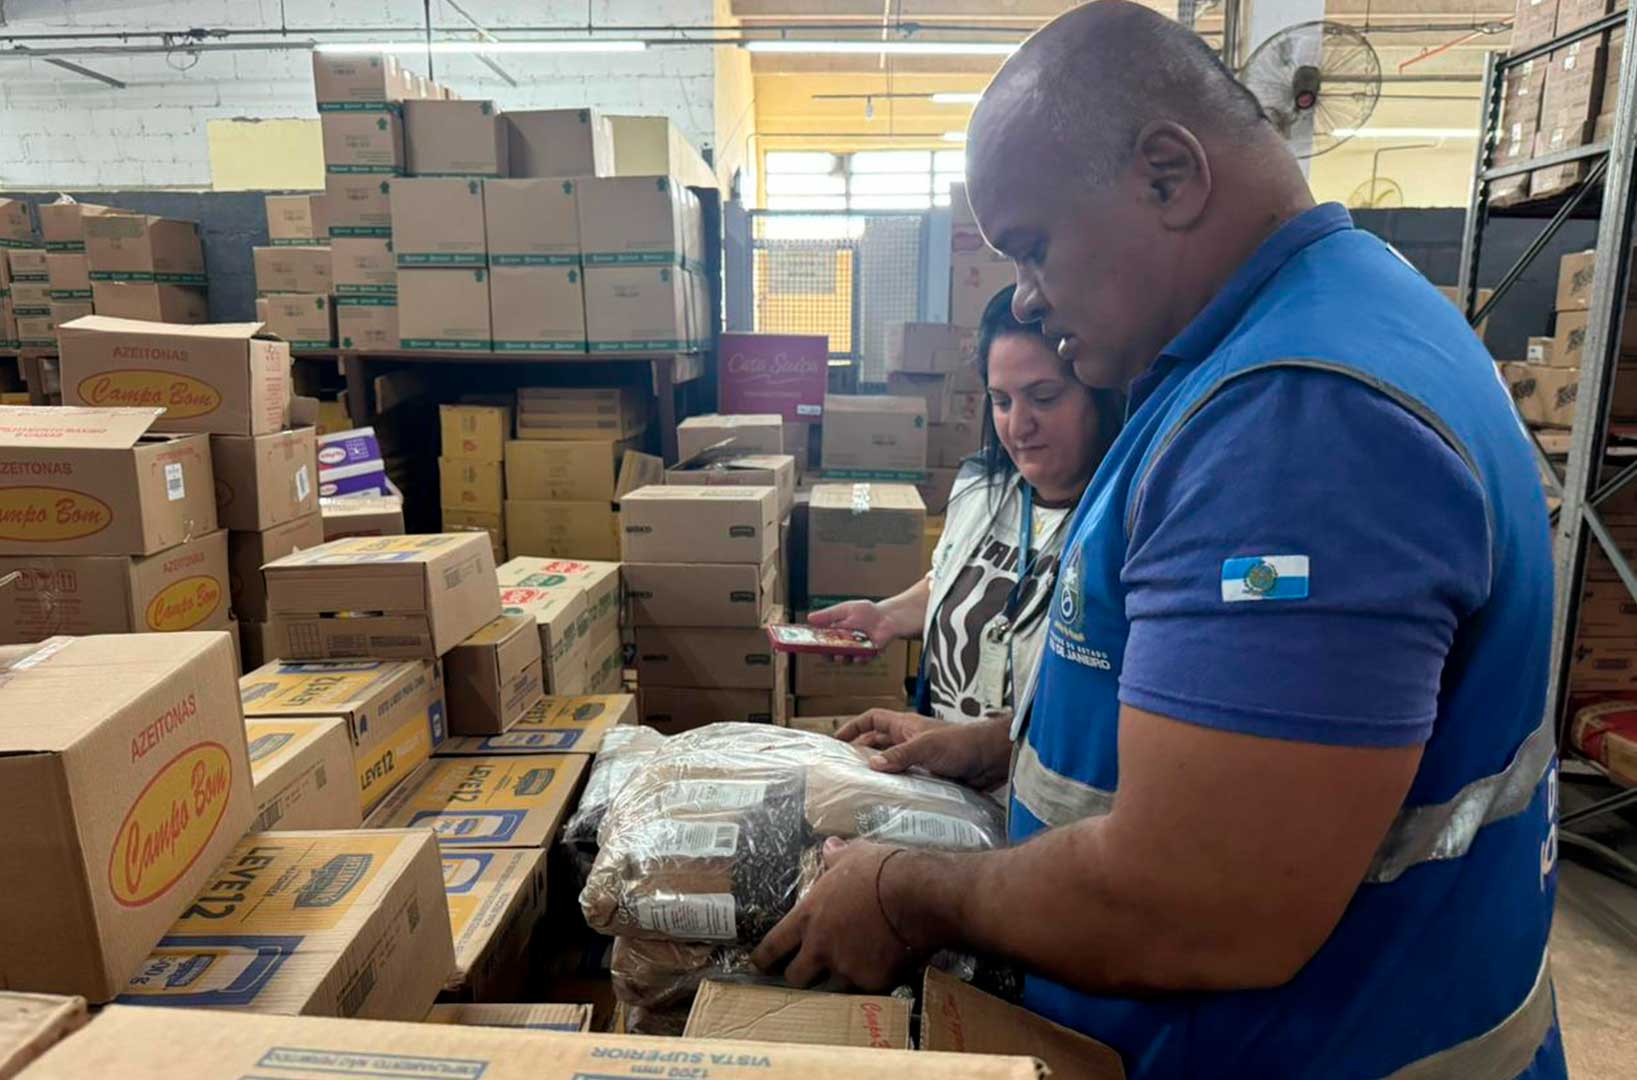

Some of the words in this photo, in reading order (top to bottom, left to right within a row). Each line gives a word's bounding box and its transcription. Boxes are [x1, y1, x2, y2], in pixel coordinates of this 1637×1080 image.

[112, 345, 188, 362] AZEITONAS
[91, 376, 163, 407] Campo
[168, 382, 212, 406] Bom
[0, 461, 73, 475] ZEITONAS
[55, 497, 101, 525] Bom
[130, 693, 198, 764] AZEITONAS
[125, 799, 190, 895] Campo
[190, 759, 227, 817] Bom
[591, 1046, 704, 1065] SUPERIOR
[710, 1054, 772, 1068] VISTA
